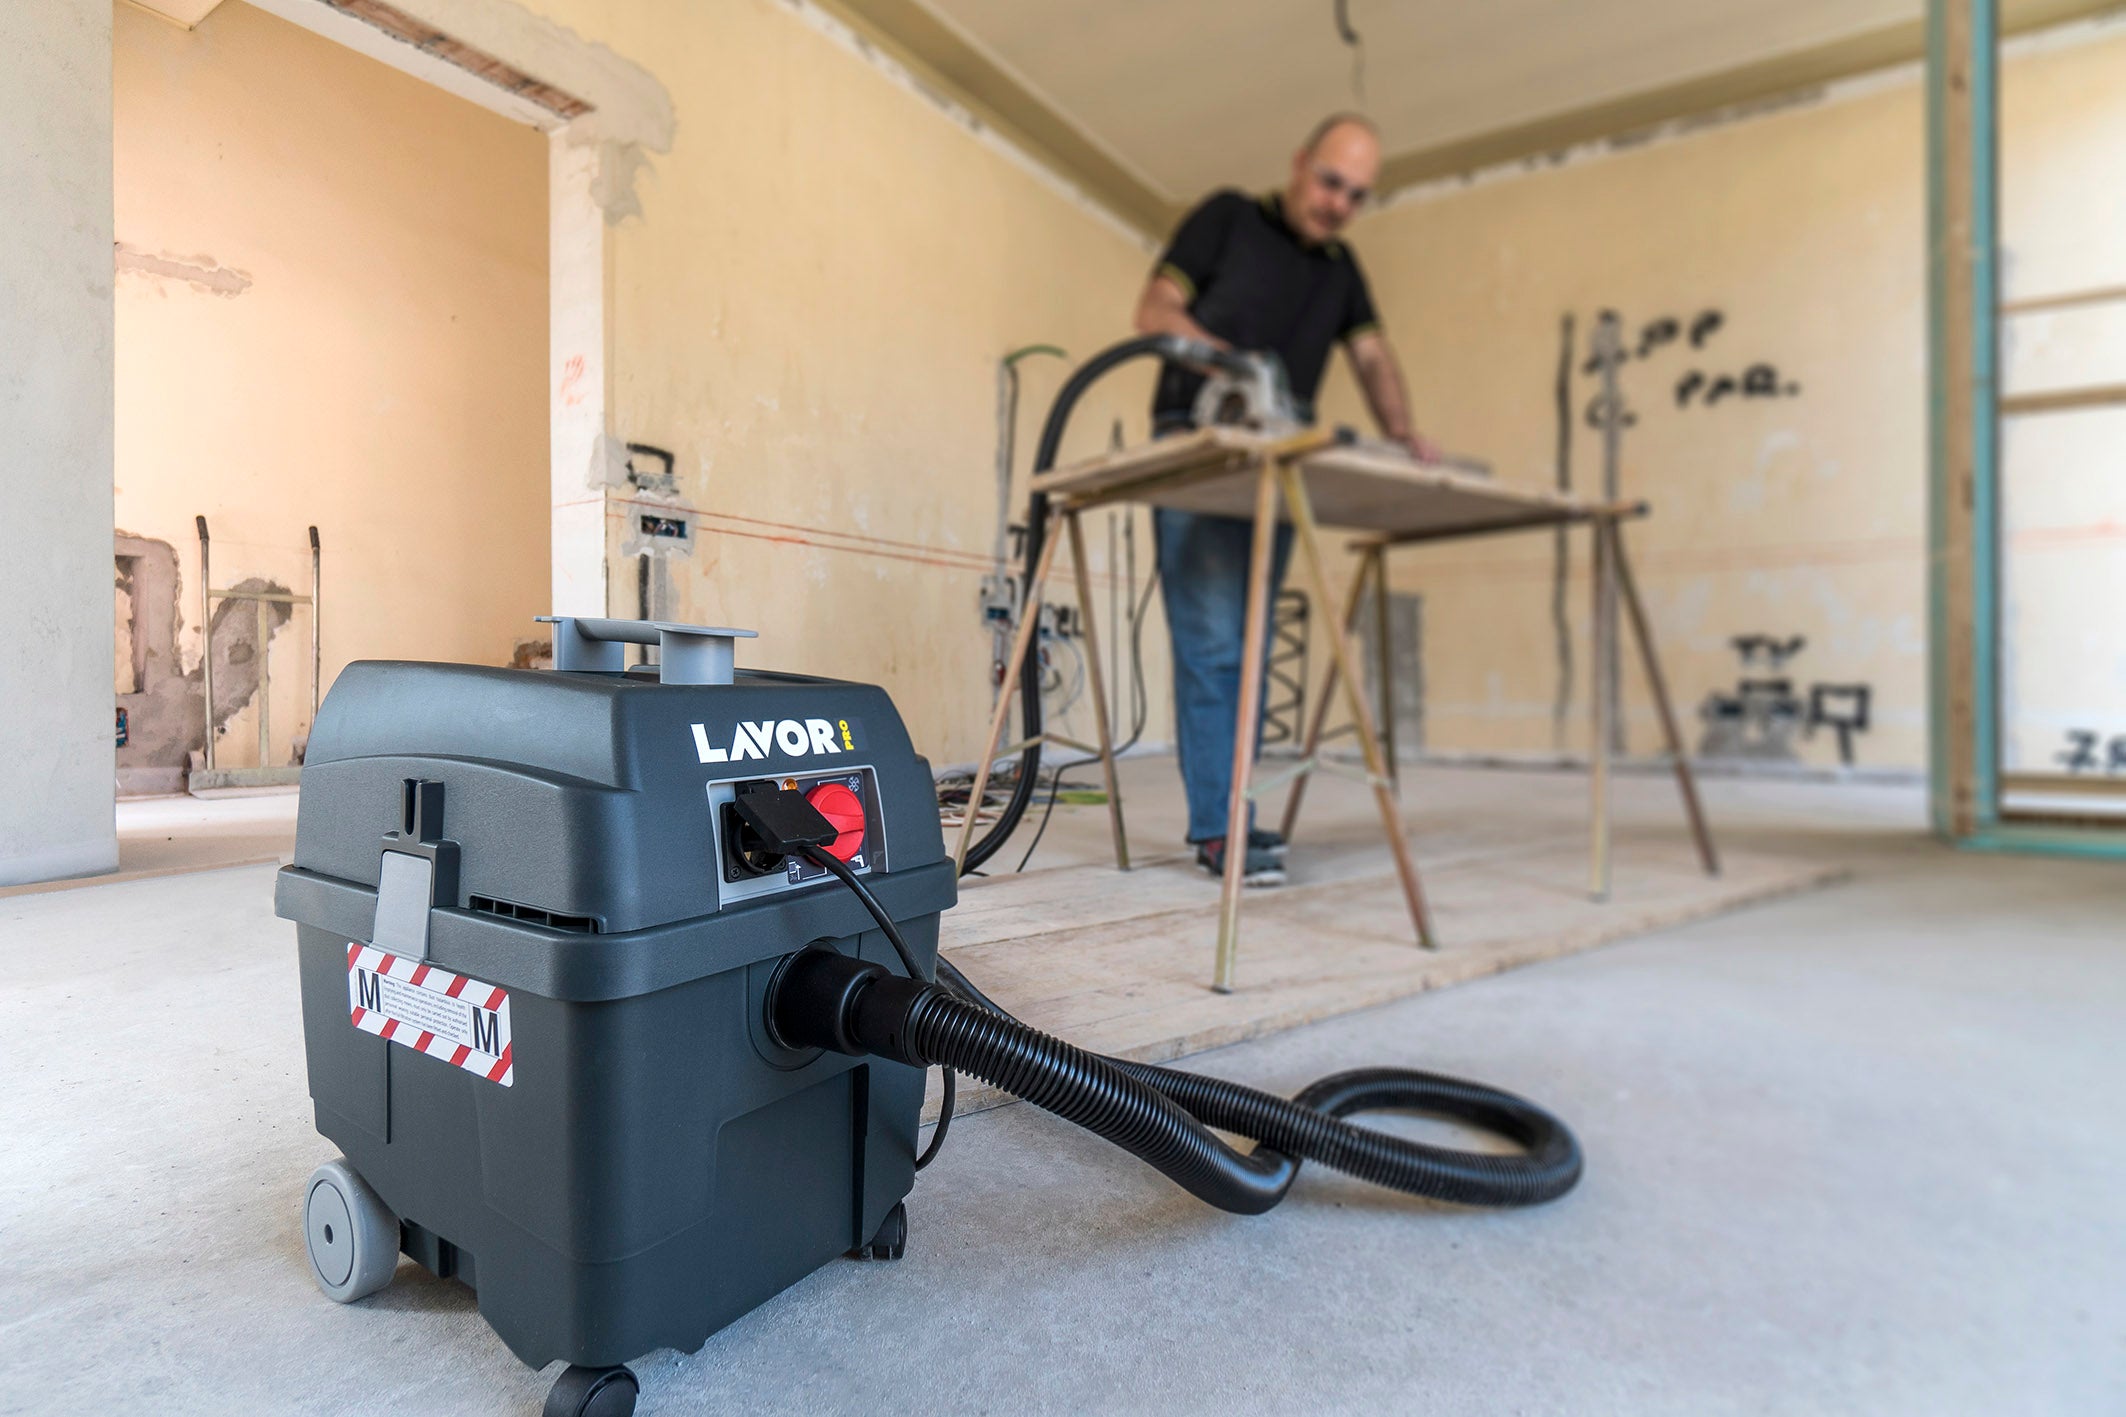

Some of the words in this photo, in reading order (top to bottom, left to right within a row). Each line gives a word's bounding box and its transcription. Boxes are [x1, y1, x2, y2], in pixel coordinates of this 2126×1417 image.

[690, 718, 841, 763] LAVOR
[838, 719, 855, 751] PRO
[358, 968, 382, 1013] M
[472, 1006, 500, 1058] M
